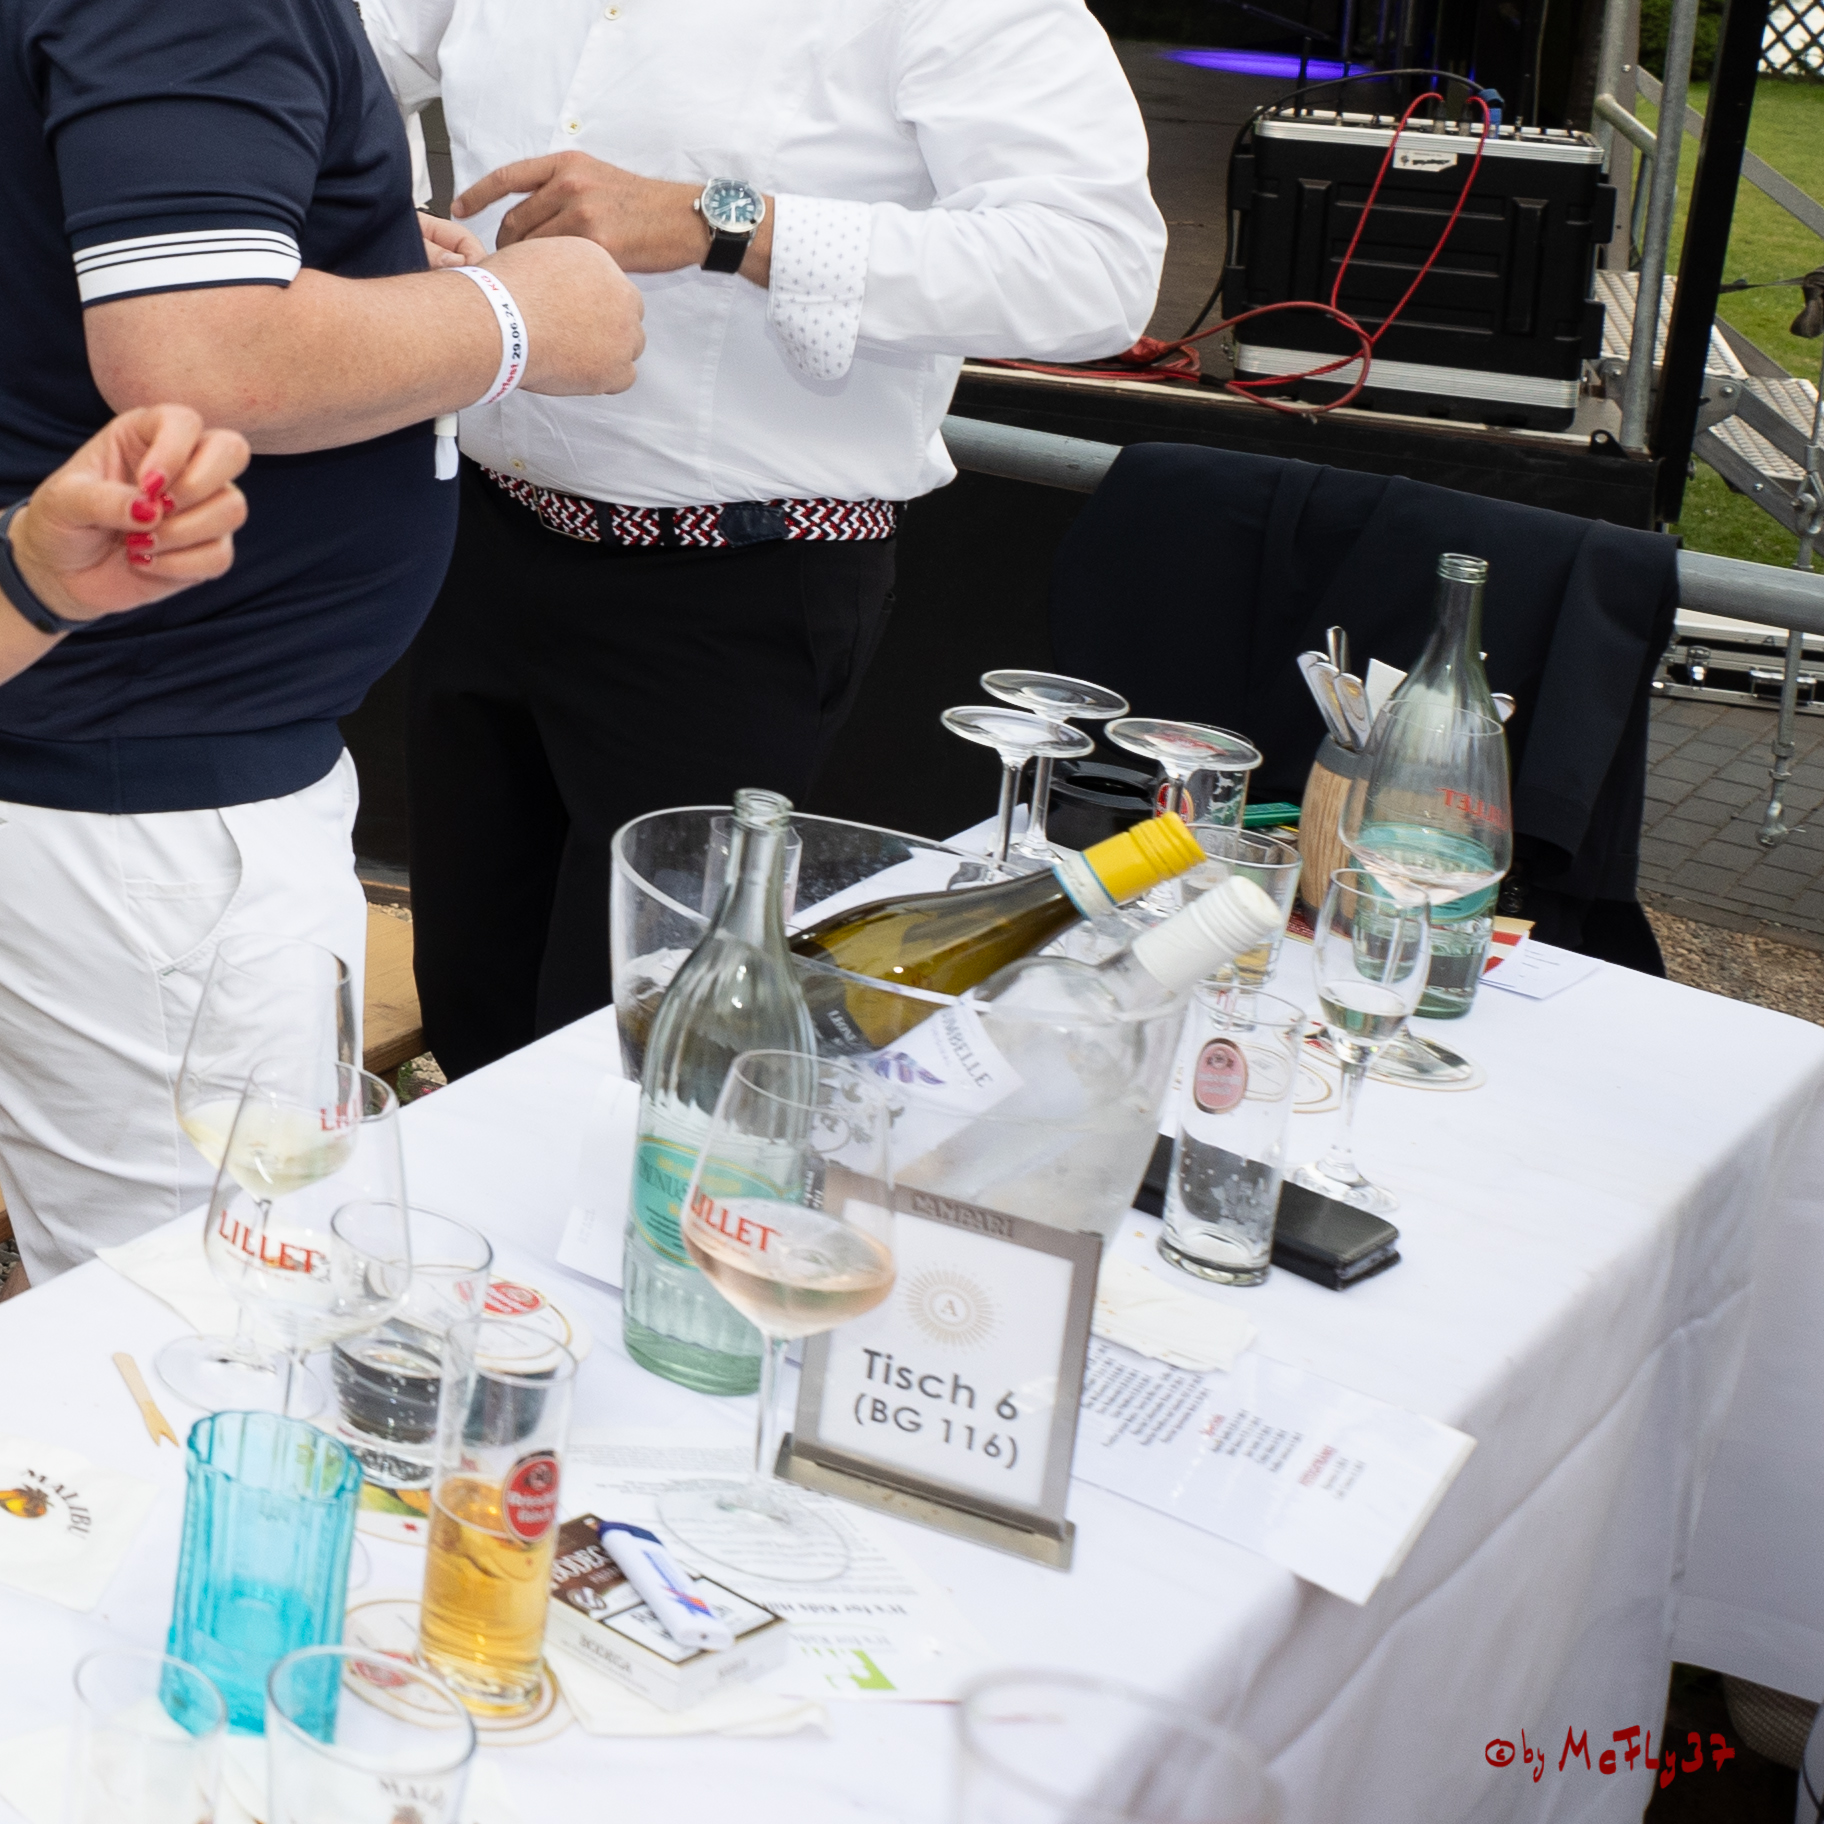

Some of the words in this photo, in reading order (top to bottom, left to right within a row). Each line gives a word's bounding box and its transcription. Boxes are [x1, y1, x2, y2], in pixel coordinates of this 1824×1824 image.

[501, 302, 521, 361] 29.06.24
[218, 1208, 328, 1274] LILLET
[862, 1347, 977, 1410] Tisch
[995, 1389, 1020, 1422] 6
[854, 1391, 923, 1435] (BG
[942, 1417, 1019, 1470] 116)
[23, 1467, 94, 1540] MALIBU
